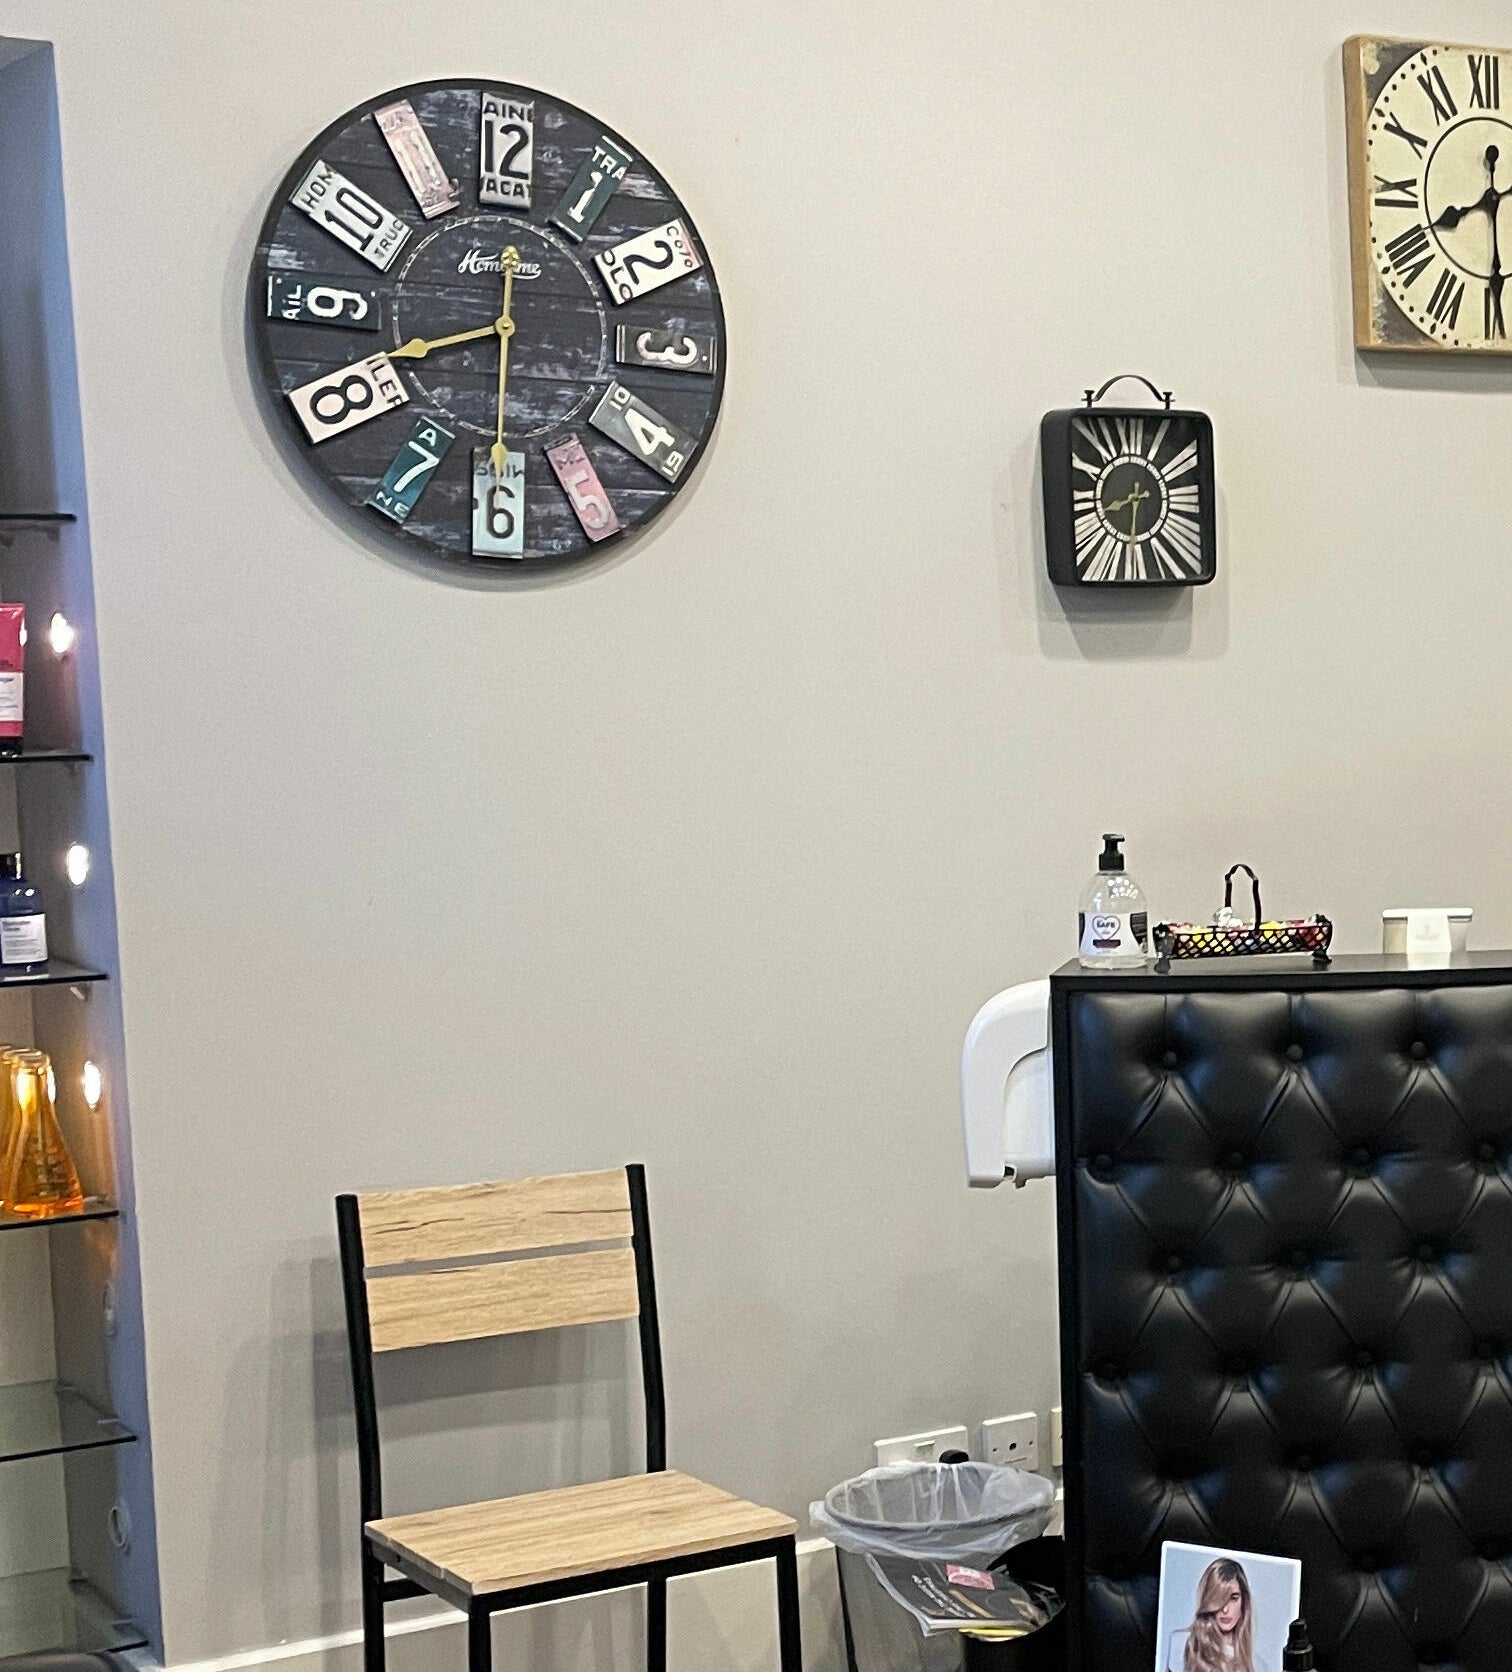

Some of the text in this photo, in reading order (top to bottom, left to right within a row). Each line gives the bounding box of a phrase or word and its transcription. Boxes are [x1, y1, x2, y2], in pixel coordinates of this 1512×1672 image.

[1416, 65, 1458, 126] XI
[1468, 54, 1500, 110] XII
[484, 120, 529, 180] 12
[592, 145, 628, 181] TRA
[324, 187, 384, 252] 10
[567, 171, 603, 223] 1
[623, 240, 673, 285] 2
[308, 286, 368, 320] 9
[636, 331, 697, 365] 3
[310, 375, 373, 425] 8
[624, 408, 675, 456] 4
[393, 441, 440, 493] 7
[487, 484, 515, 539] 6
[563, 470, 610, 529] 5
